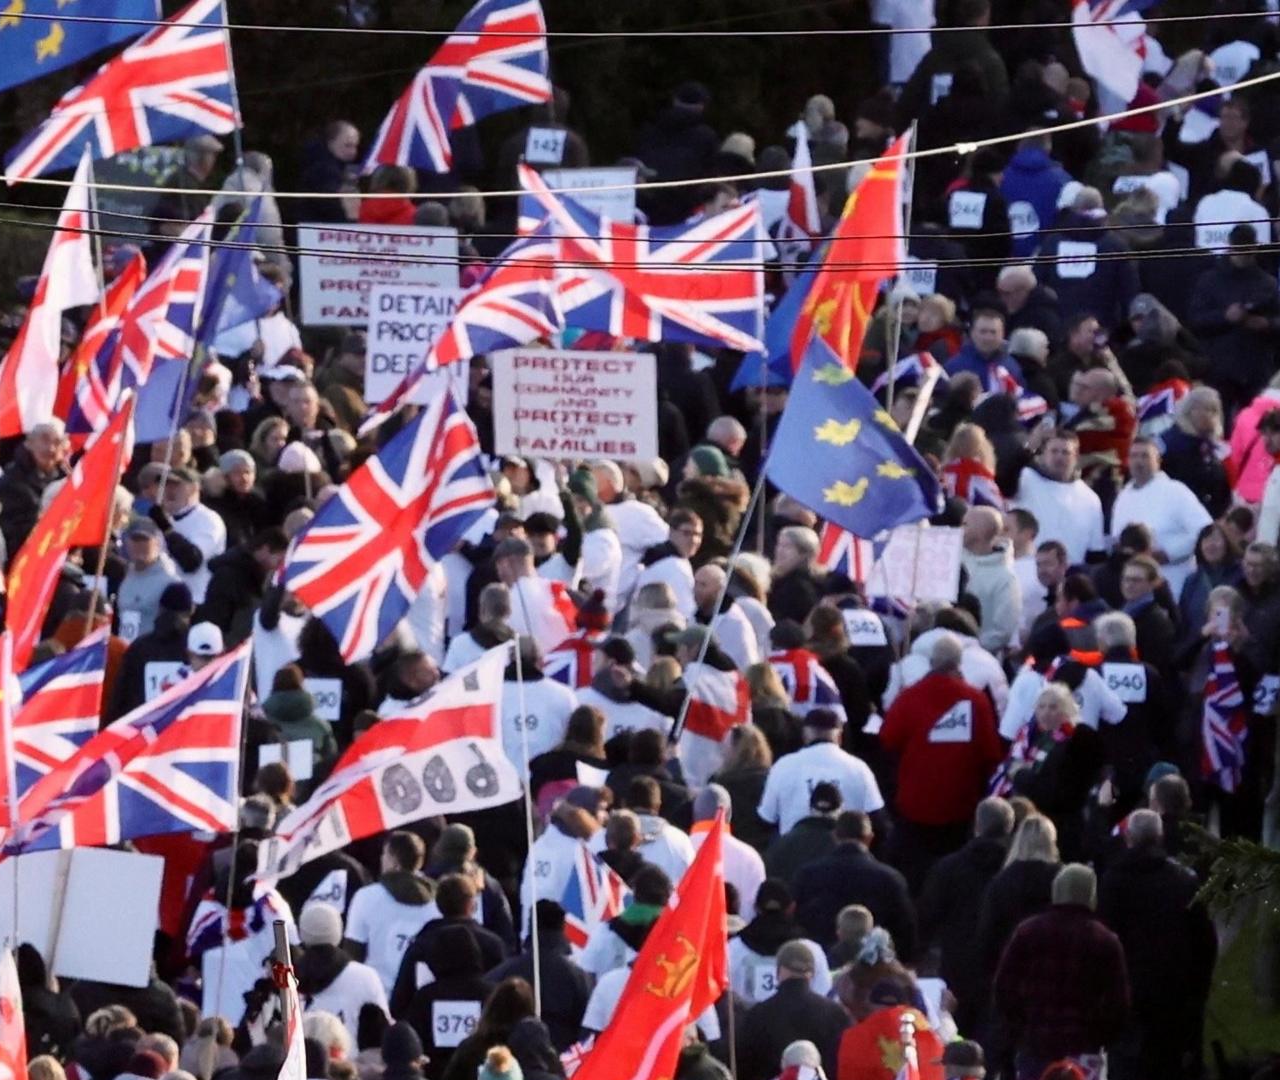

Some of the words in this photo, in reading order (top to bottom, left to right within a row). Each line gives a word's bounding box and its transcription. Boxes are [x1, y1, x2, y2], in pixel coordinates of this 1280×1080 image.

[319, 231, 435, 246] PROTECT
[513, 356, 636, 374] PROTECT
[513, 383, 634, 398] COMMUNITY
[554, 398, 597, 408] AND
[513, 408, 637, 426] PROTECT
[514, 436, 637, 454] FAMILIES
[1108, 672, 1144, 691] 540
[436, 1015, 478, 1035] 379
